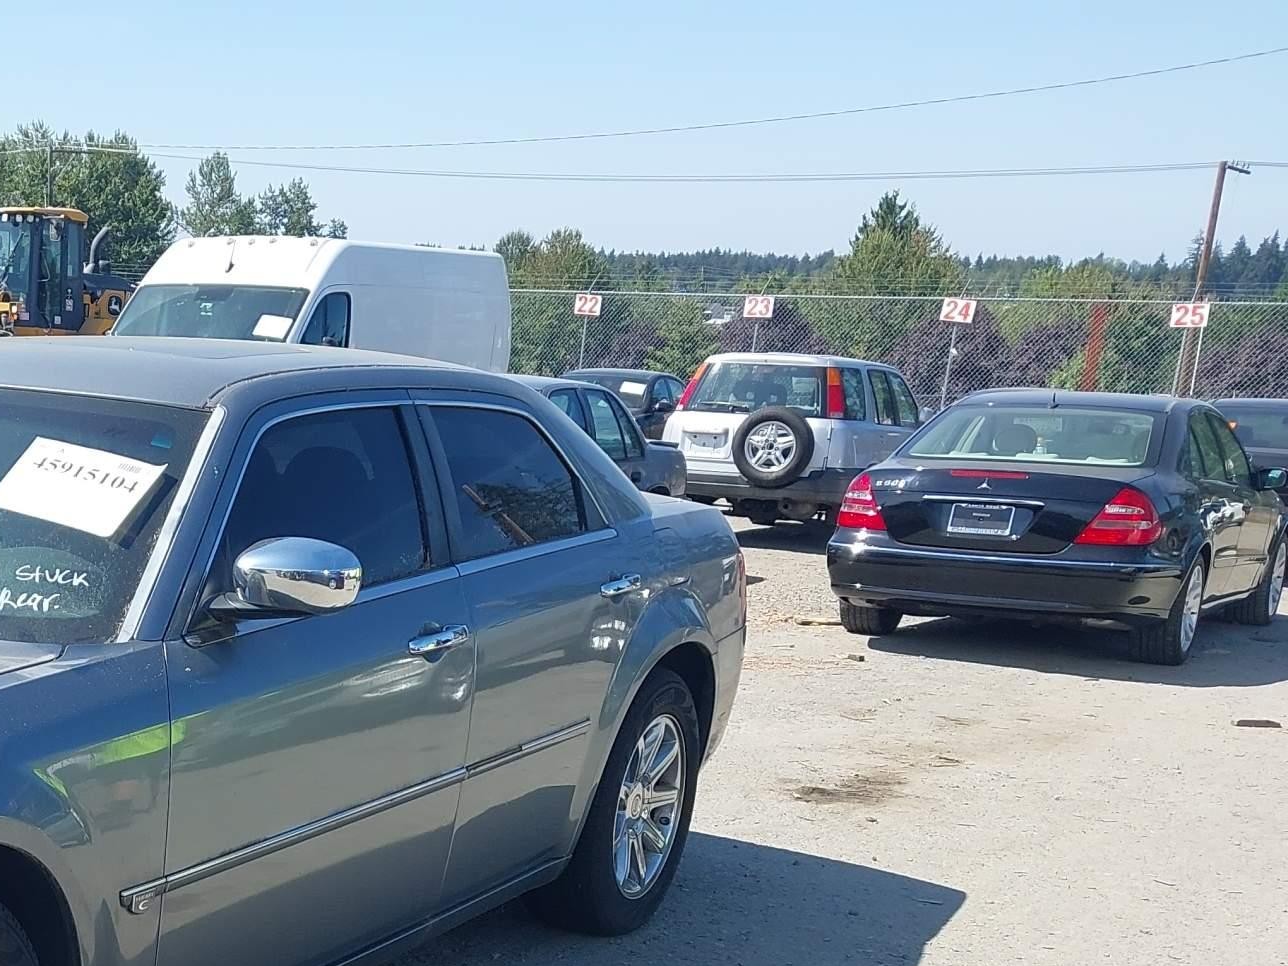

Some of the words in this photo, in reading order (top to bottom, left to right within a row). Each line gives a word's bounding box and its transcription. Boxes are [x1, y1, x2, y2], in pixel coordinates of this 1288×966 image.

[576, 295, 599, 314] 22
[746, 297, 771, 316] 23
[942, 300, 972, 321] 24
[1174, 304, 1205, 326] 25
[33, 456, 139, 493] 45915104
